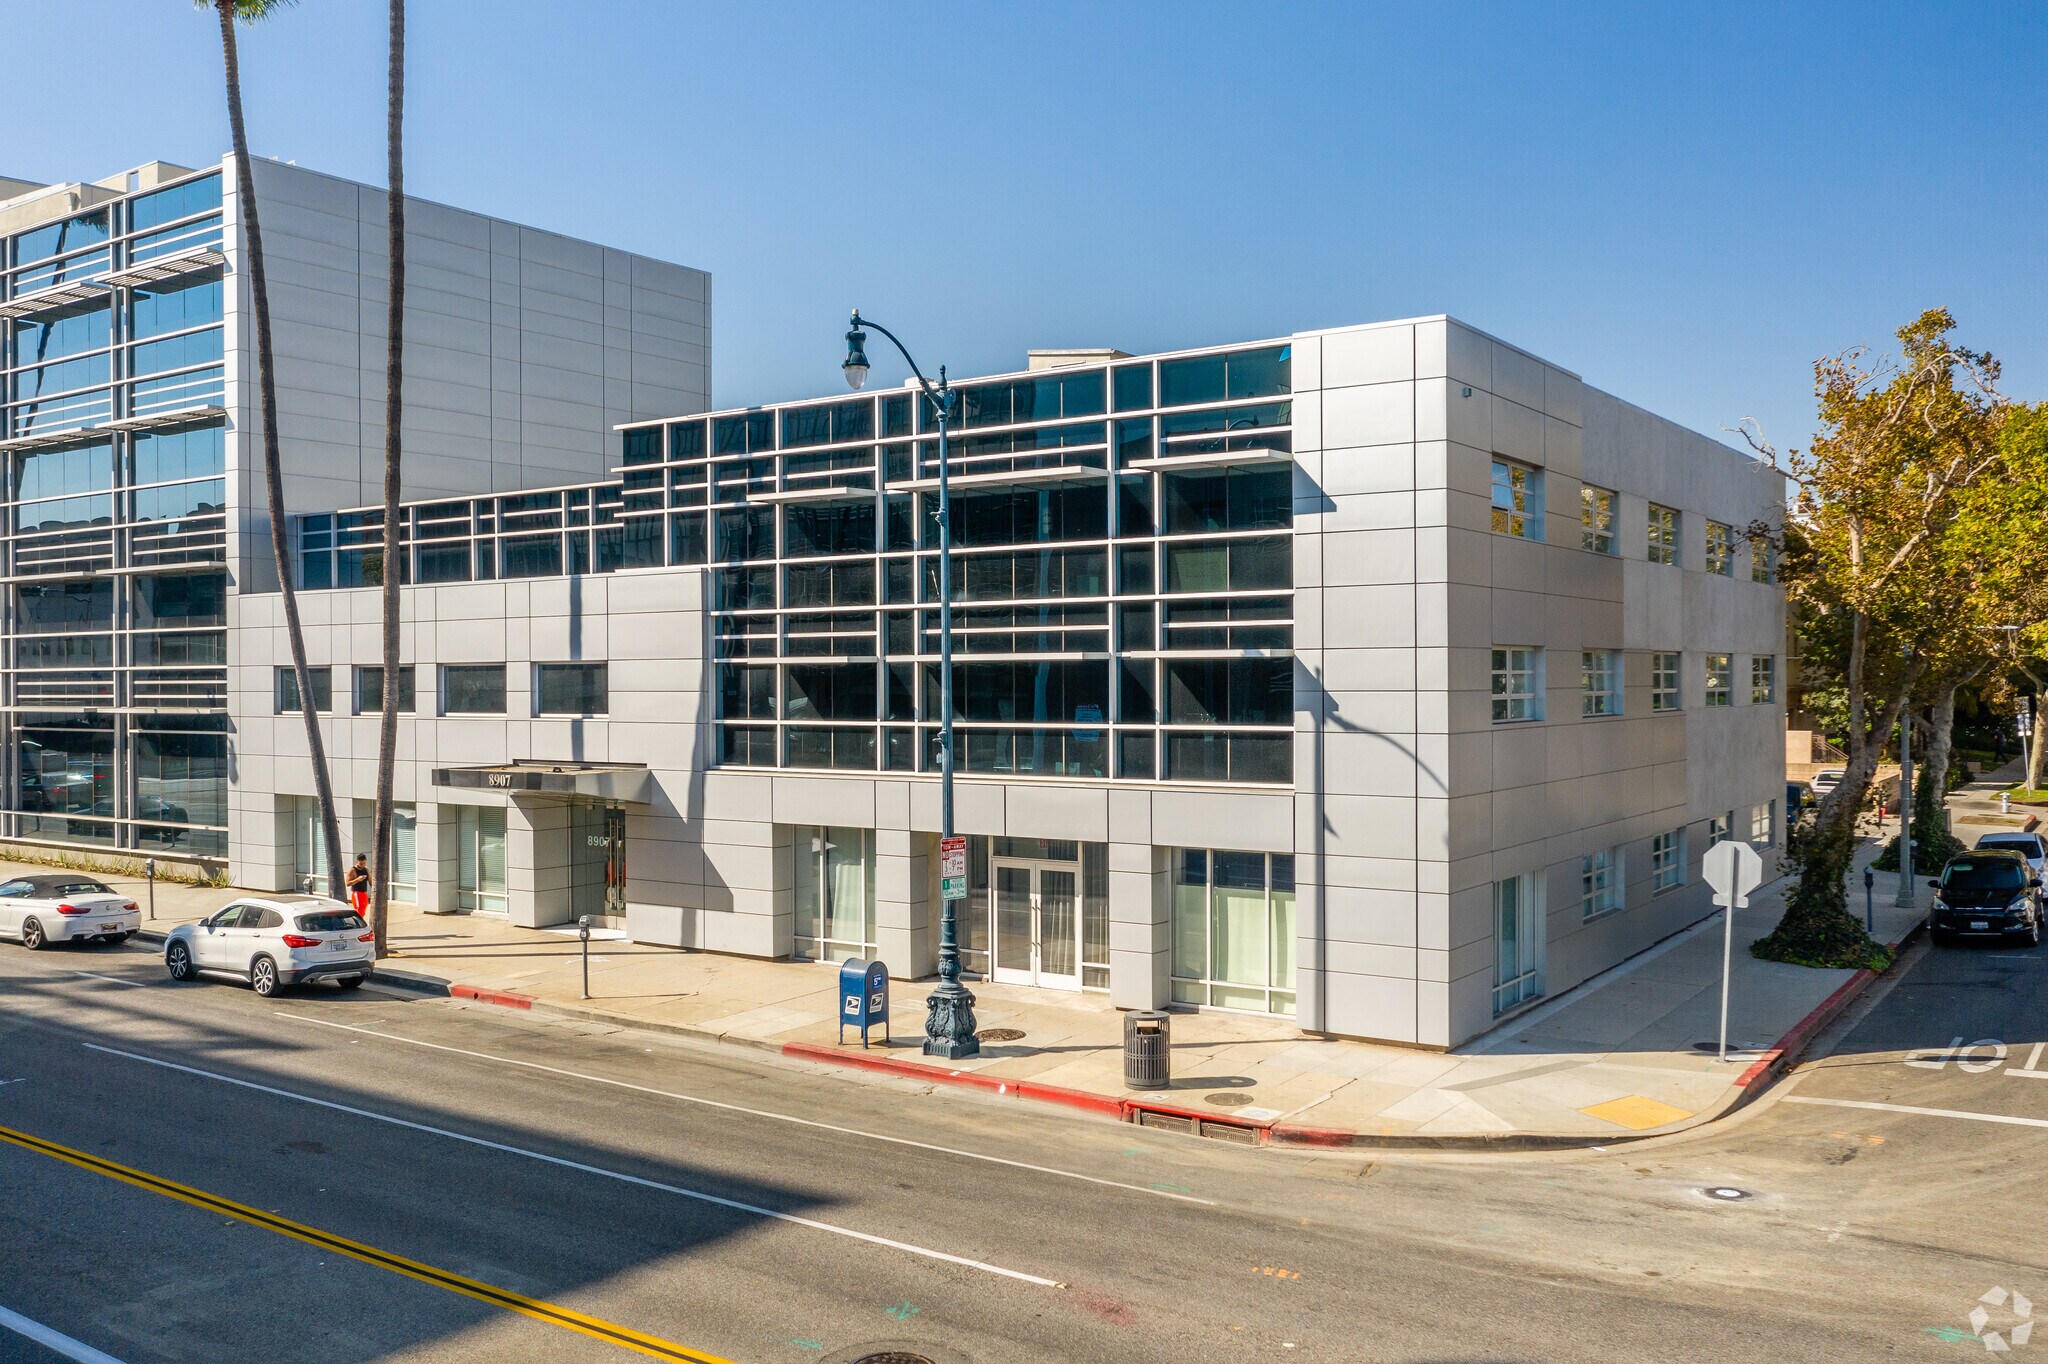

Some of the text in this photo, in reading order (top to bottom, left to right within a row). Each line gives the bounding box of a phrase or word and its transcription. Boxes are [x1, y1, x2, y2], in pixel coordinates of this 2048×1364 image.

[488, 774, 512, 787] 8907
[587, 835, 610, 848] 8907
[942, 850, 949, 859] NO
